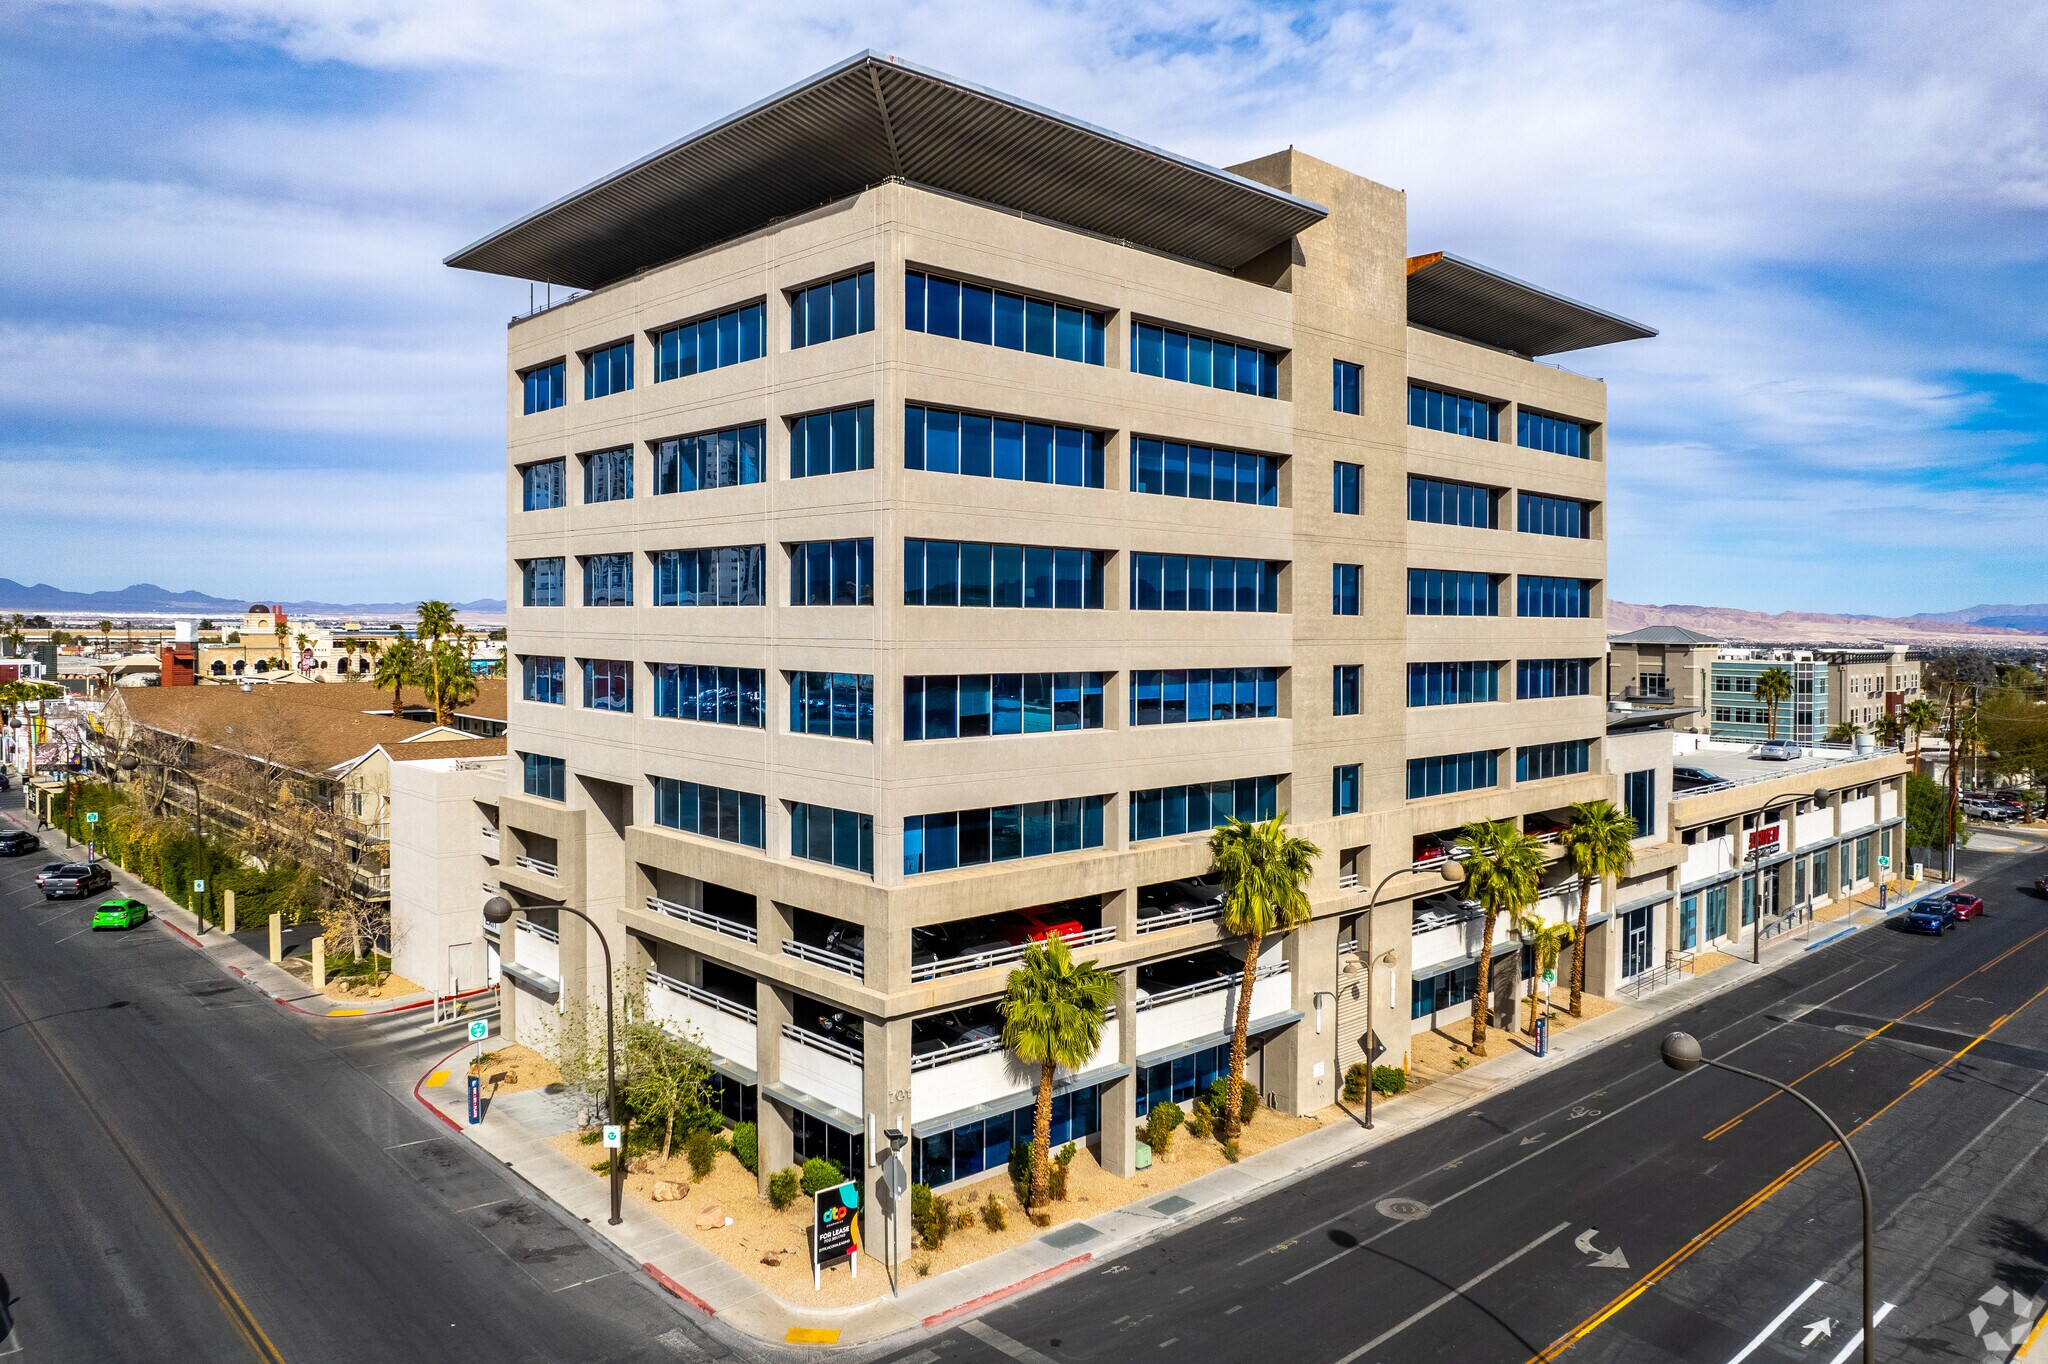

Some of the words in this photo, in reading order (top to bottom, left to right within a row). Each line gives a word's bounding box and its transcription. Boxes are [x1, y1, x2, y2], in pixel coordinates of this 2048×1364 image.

[823, 1206, 847, 1223] dtp
[819, 1231, 832, 1240] FOR
[832, 1225, 850, 1237] LEASE
